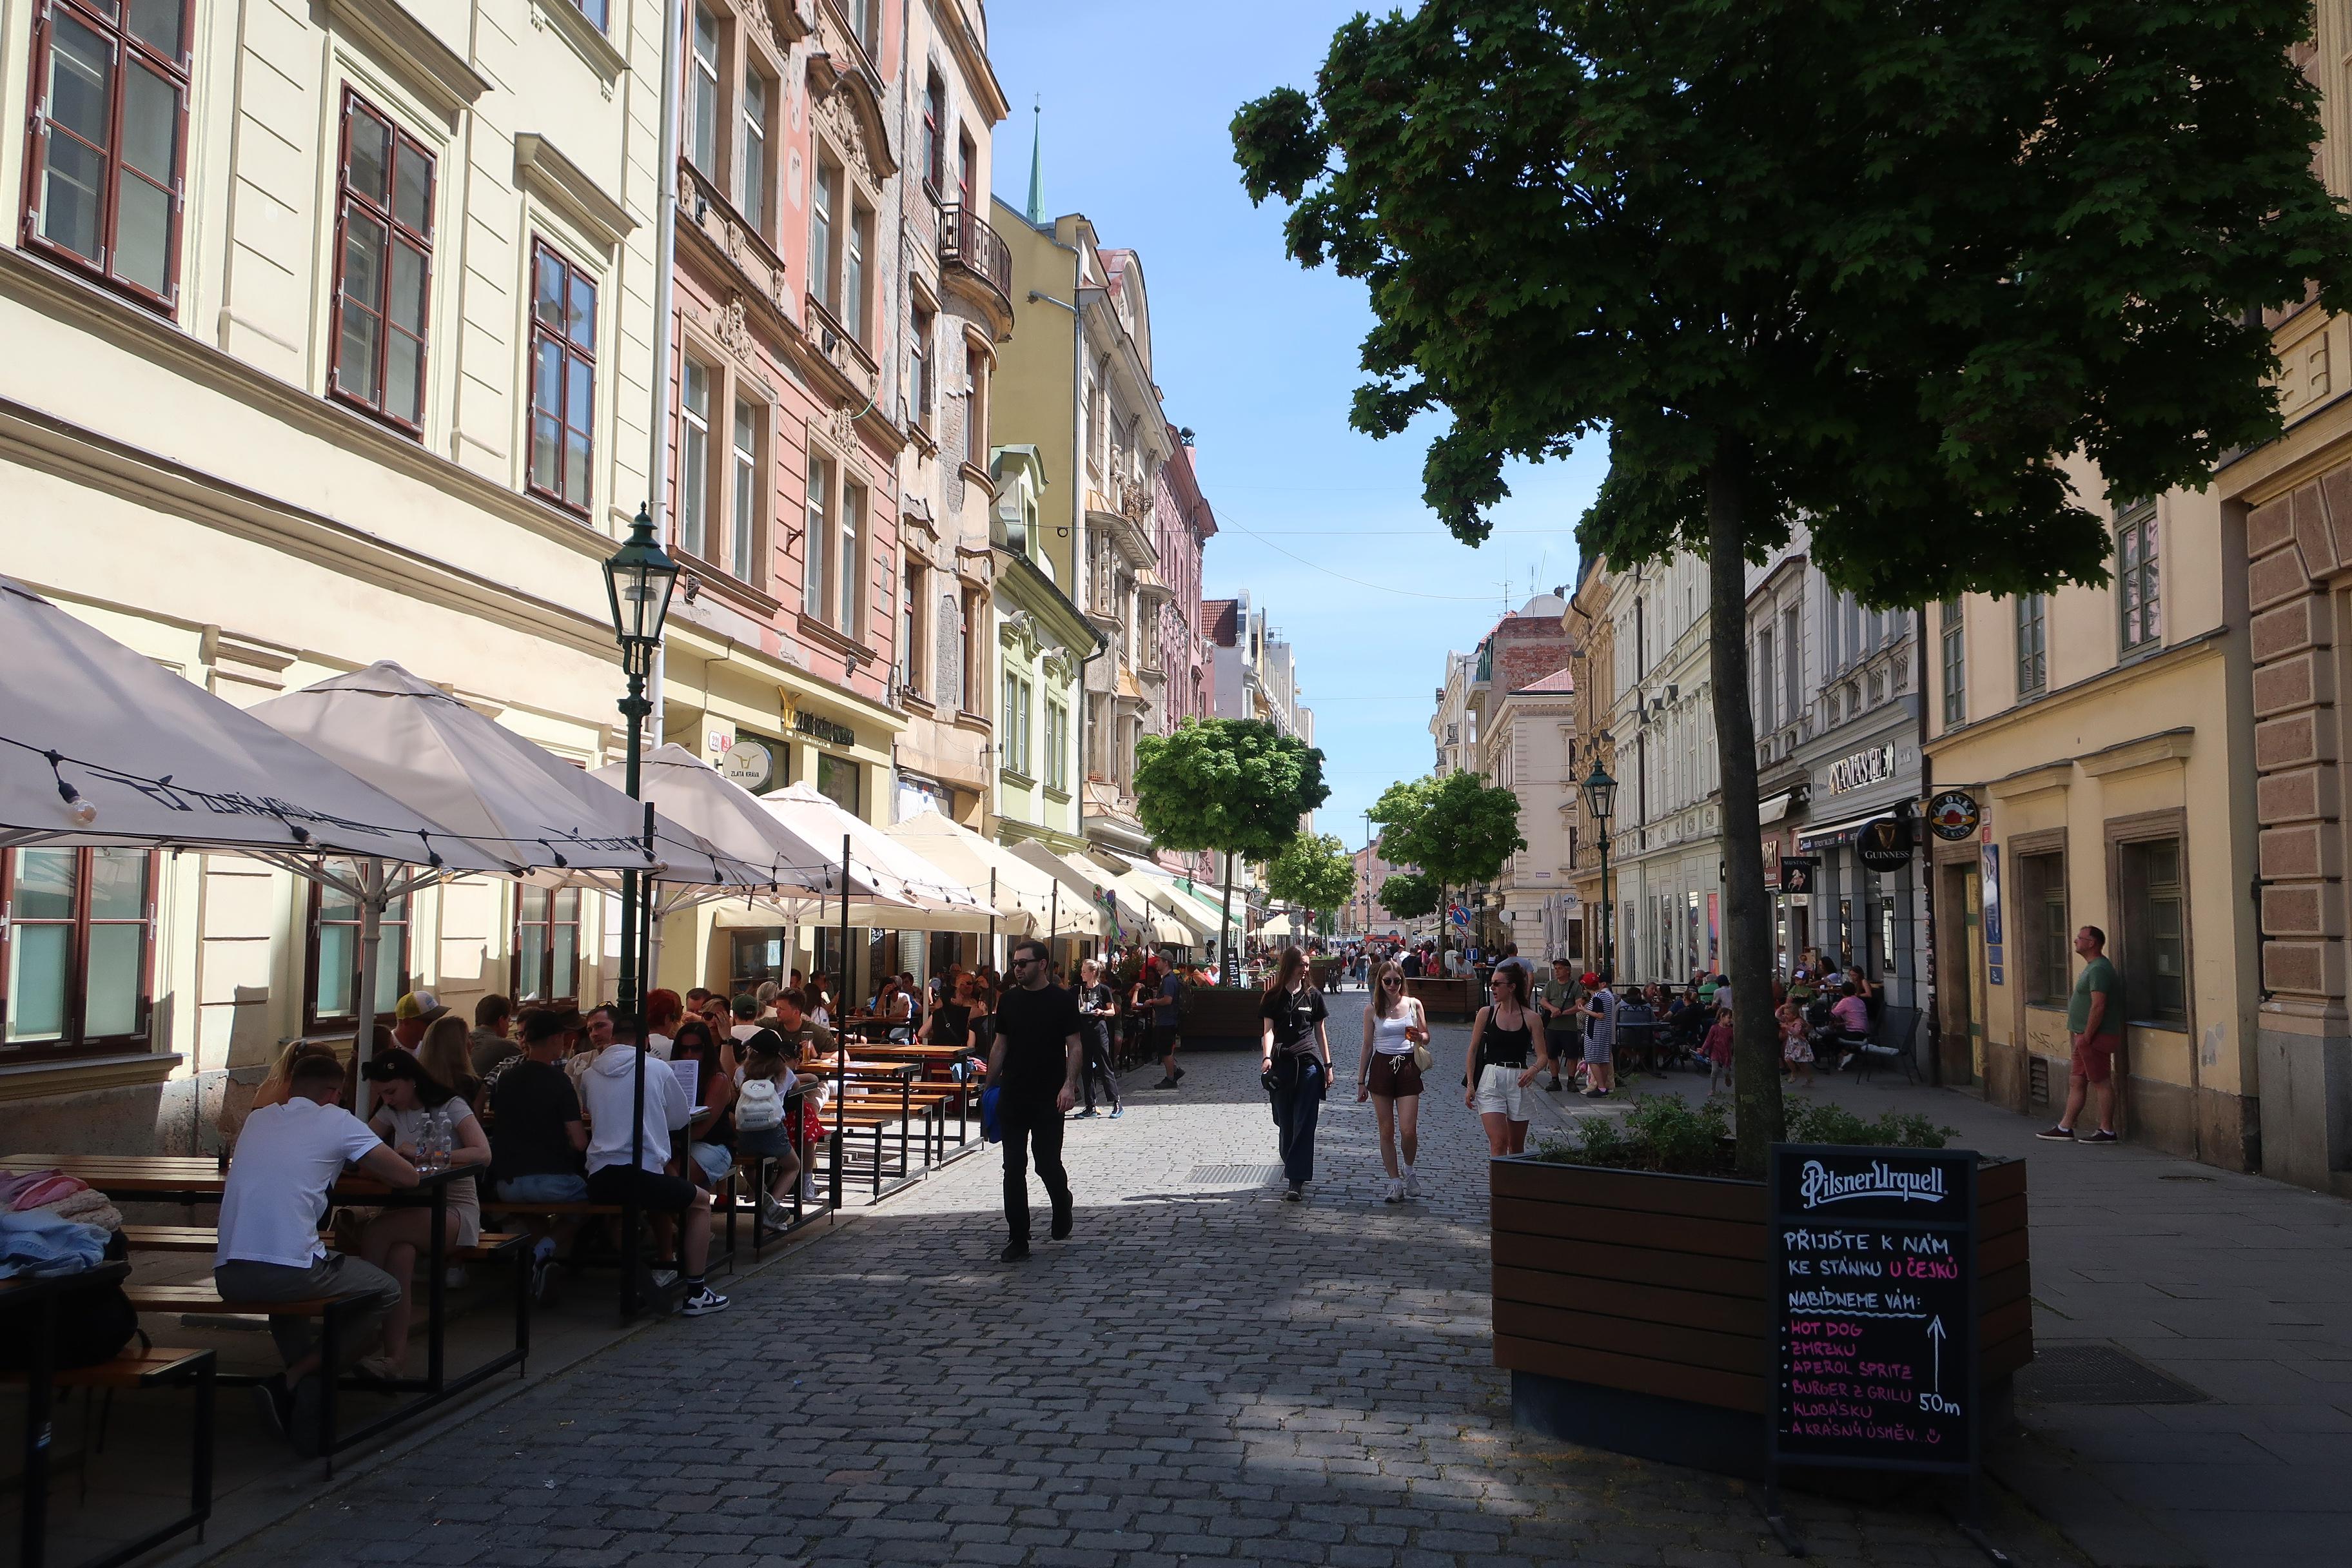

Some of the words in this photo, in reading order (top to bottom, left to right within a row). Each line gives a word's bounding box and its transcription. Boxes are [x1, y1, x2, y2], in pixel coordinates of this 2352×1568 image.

[1865, 850, 1910, 859] GUINNESS
[1801, 1160, 1874, 1209] Pilsner
[1871, 1161, 1944, 1202] Urquell
[1783, 1228, 1870, 1251] PŘIJĎTE
[1881, 1234, 1894, 1251] K
[1903, 1233, 1949, 1255] NÁM
[1788, 1259, 1811, 1277] KE
[1819, 1255, 1883, 1277] STÁNKU
[1889, 1260, 1902, 1277] U
[1906, 1256, 1959, 1279] ČEJKŮ
[1788, 1286, 1879, 1308] NABÍDNEME
[1885, 1288, 1921, 1310] VÁM:
[1790, 1319, 1821, 1335] HOT
[1825, 1322, 1865, 1337] DOG
[1790, 1340, 1857, 1357] ZMRZKU
[1792, 1359, 1854, 1376] APEROL
[1858, 1361, 1914, 1380] SPRITZ
[1792, 1378, 1850, 1398] BURGER
[1853, 1385, 1864, 1398] Z
[1867, 1386, 1913, 1404] GRILU
[1792, 1399, 1874, 1419] KLOBÁSKU
[1919, 1393, 1961, 1417] 50m
[1792, 1420, 1803, 1436] A
